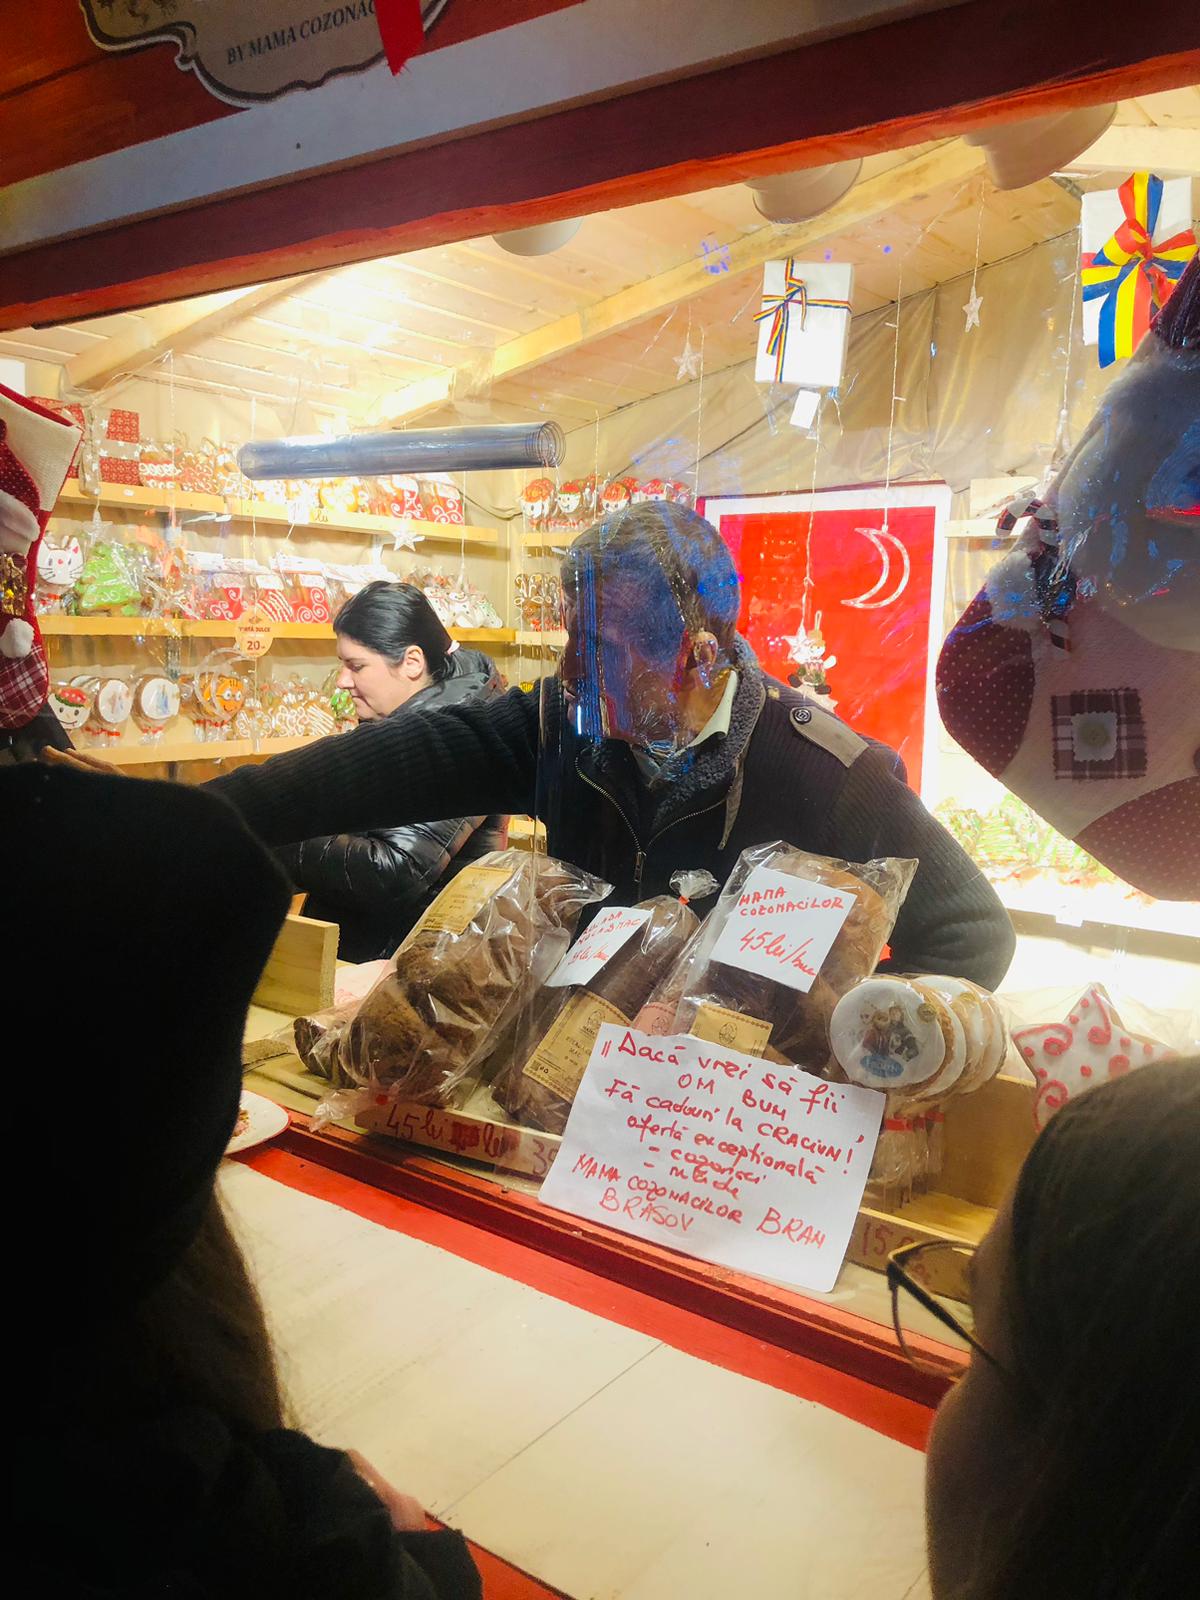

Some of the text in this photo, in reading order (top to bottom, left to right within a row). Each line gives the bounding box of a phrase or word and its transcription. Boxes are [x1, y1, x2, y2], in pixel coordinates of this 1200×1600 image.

[227, 0, 376, 65] BY MAMA COZONAC
[247, 640, 261, 651] 20
[678, 1074, 715, 1095] OM
[799, 1084, 845, 1116] fii
[725, 1106, 743, 1133] la
[572, 1153, 622, 1183] MAMA
